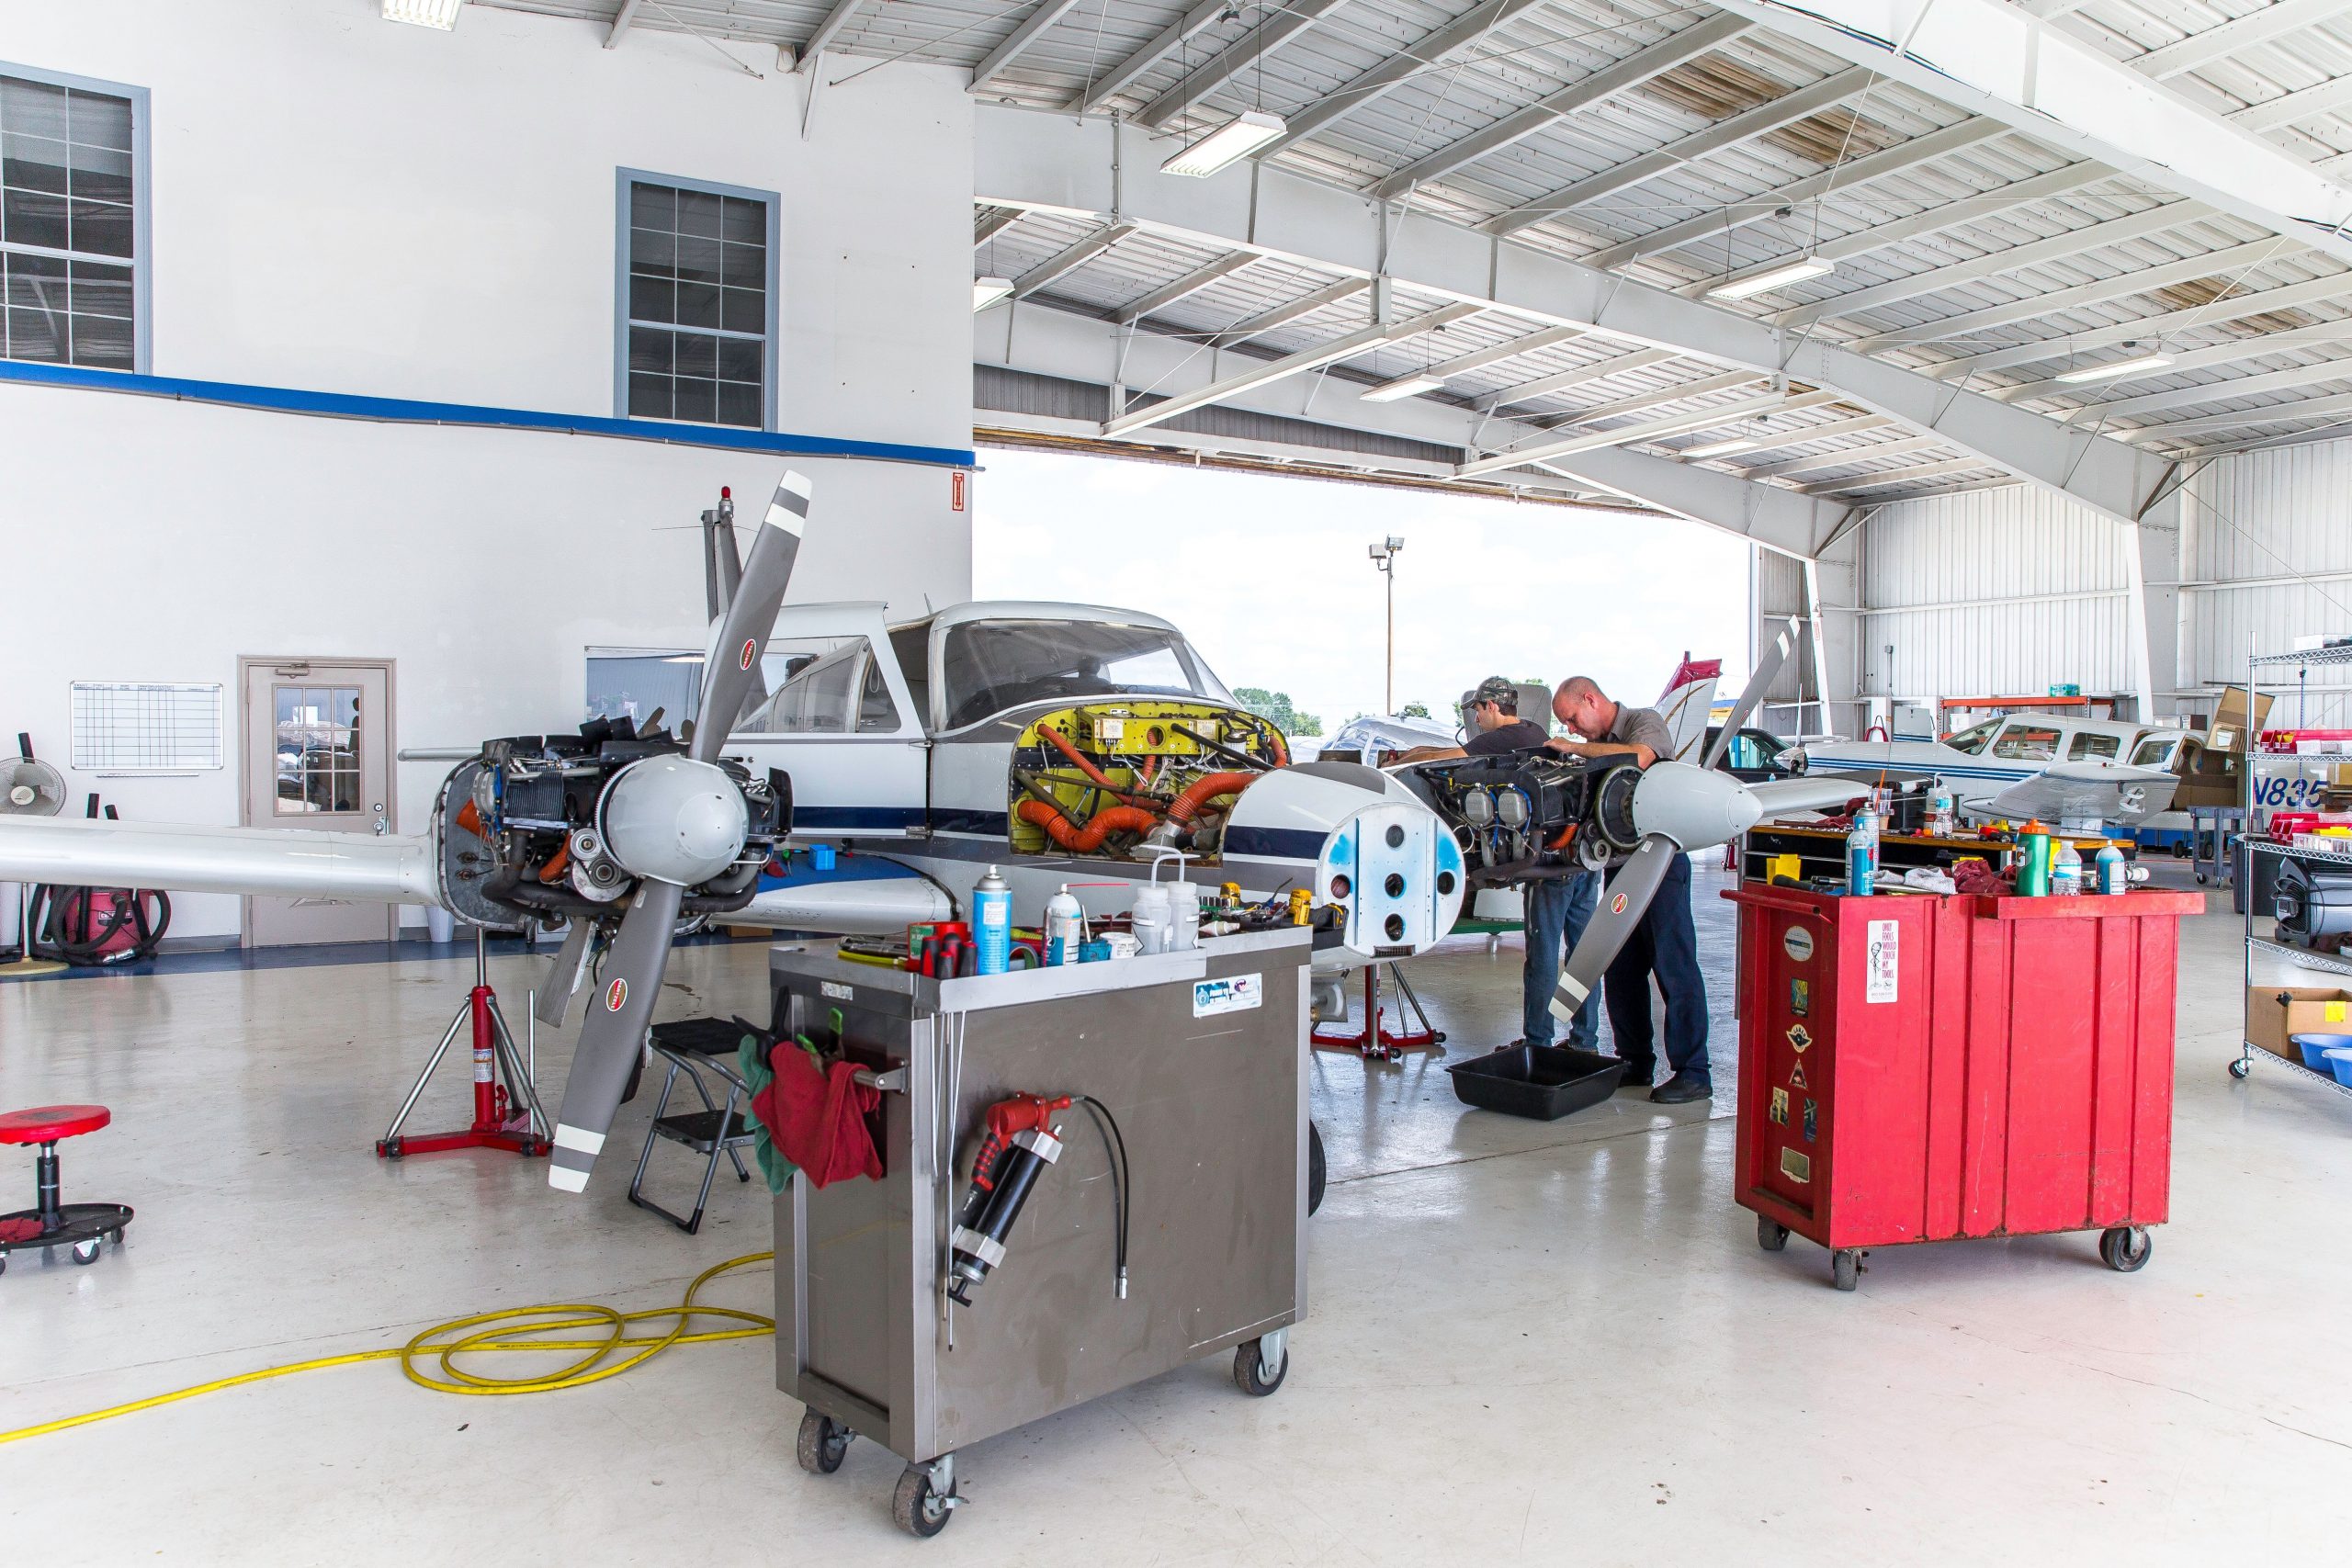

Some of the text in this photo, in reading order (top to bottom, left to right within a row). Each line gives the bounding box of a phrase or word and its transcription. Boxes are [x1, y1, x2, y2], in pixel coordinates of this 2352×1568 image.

[1883, 932, 1894, 942] FOOLS
[1883, 942, 1896, 951] WOULD
[1883, 951, 1895, 960] TOUCH
[1883, 961, 1889, 969] MY
[610, 979, 623, 1010] HARTZELL
